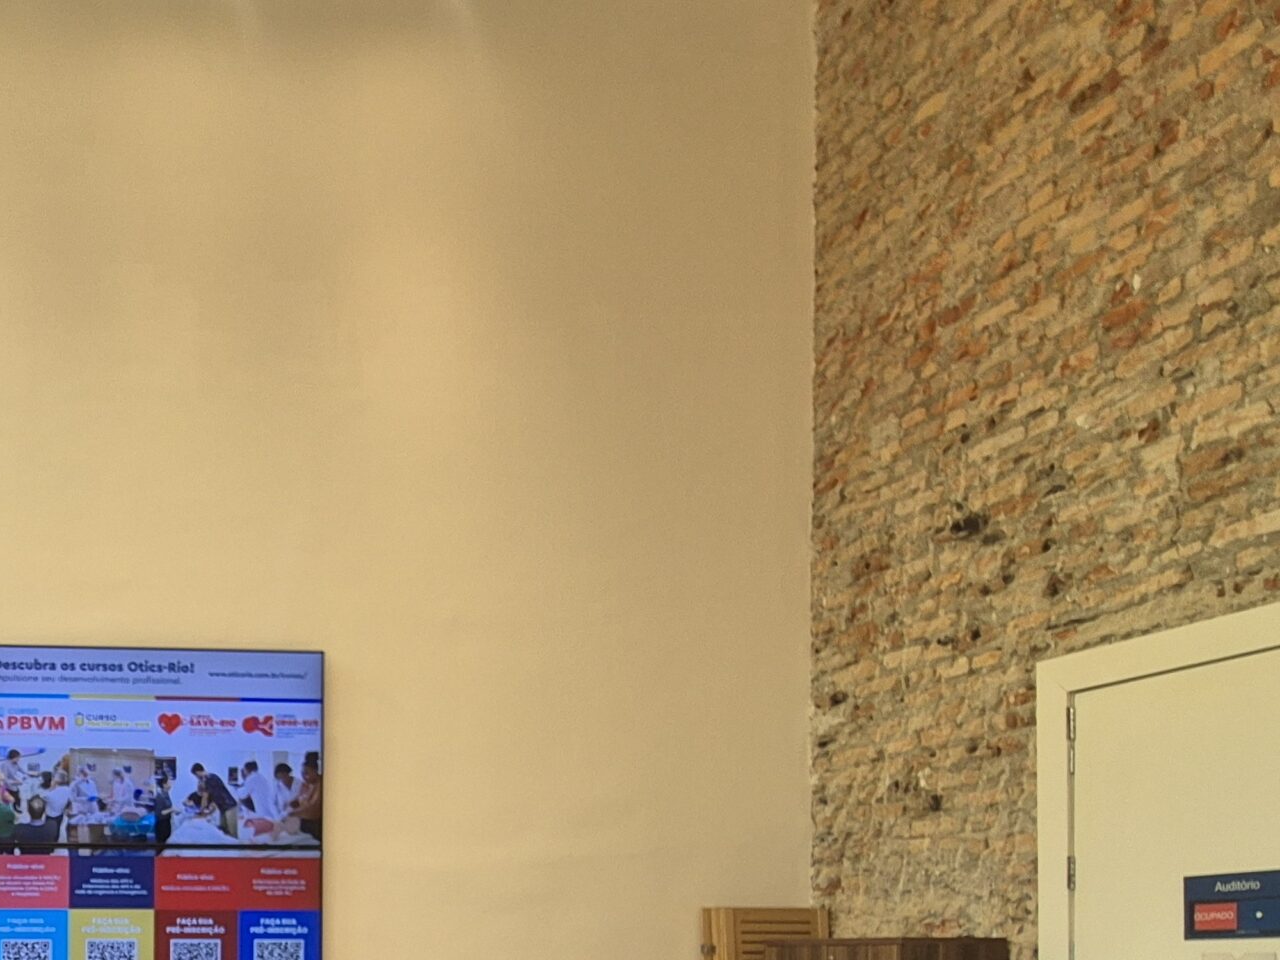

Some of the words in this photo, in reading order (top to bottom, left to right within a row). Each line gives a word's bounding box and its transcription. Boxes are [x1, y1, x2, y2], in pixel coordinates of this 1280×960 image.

[60, 662, 76, 671] os
[79, 662, 124, 672] cursos
[127, 660, 195, 674] Otics-Rio!
[7, 716, 65, 731] PBVM
[1214, 880, 1261, 893] Auditório
[176, 917, 198, 926] FAÇA
[260, 917, 281, 926] FAÇA
[1194, 911, 1235, 922] OCUPADO
